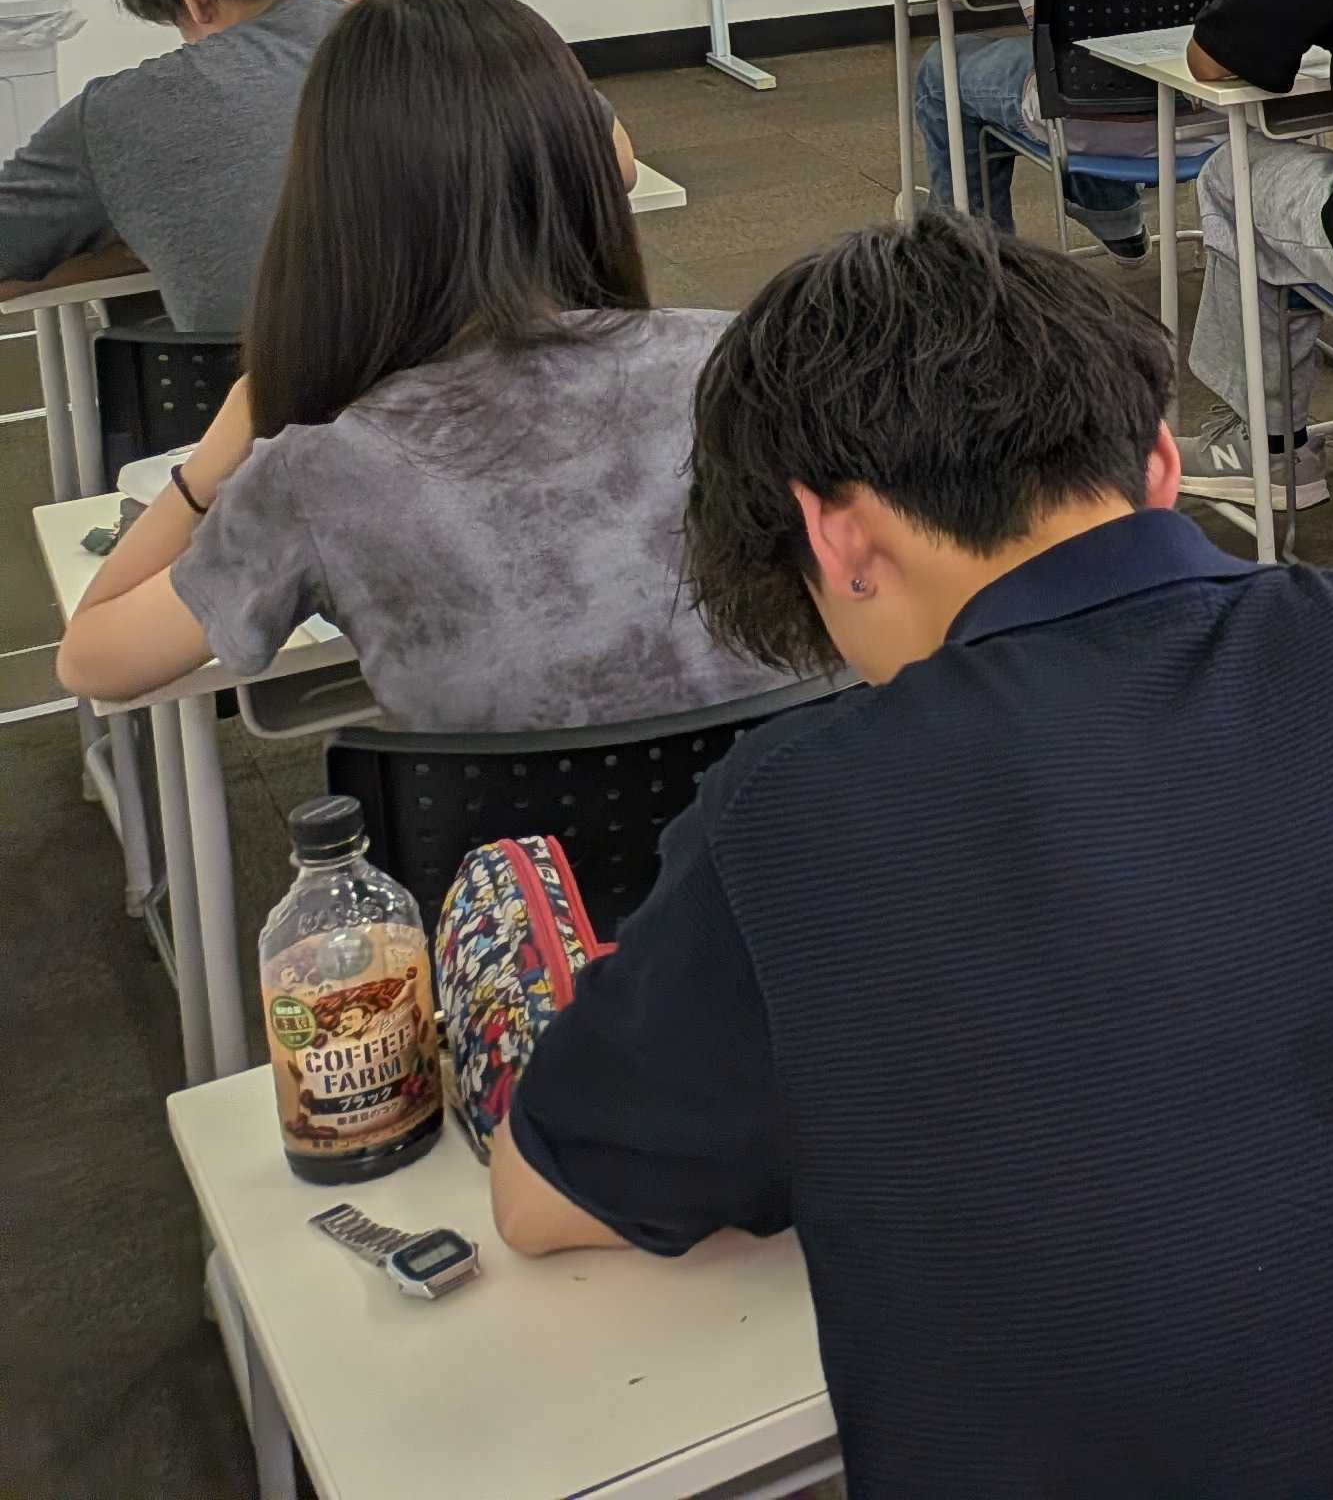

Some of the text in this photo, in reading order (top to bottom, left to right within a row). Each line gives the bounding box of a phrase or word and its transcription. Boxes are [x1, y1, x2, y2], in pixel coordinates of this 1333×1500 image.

[323, 1056, 402, 1094] FARM
[338, 1086, 393, 1112] ブラック
